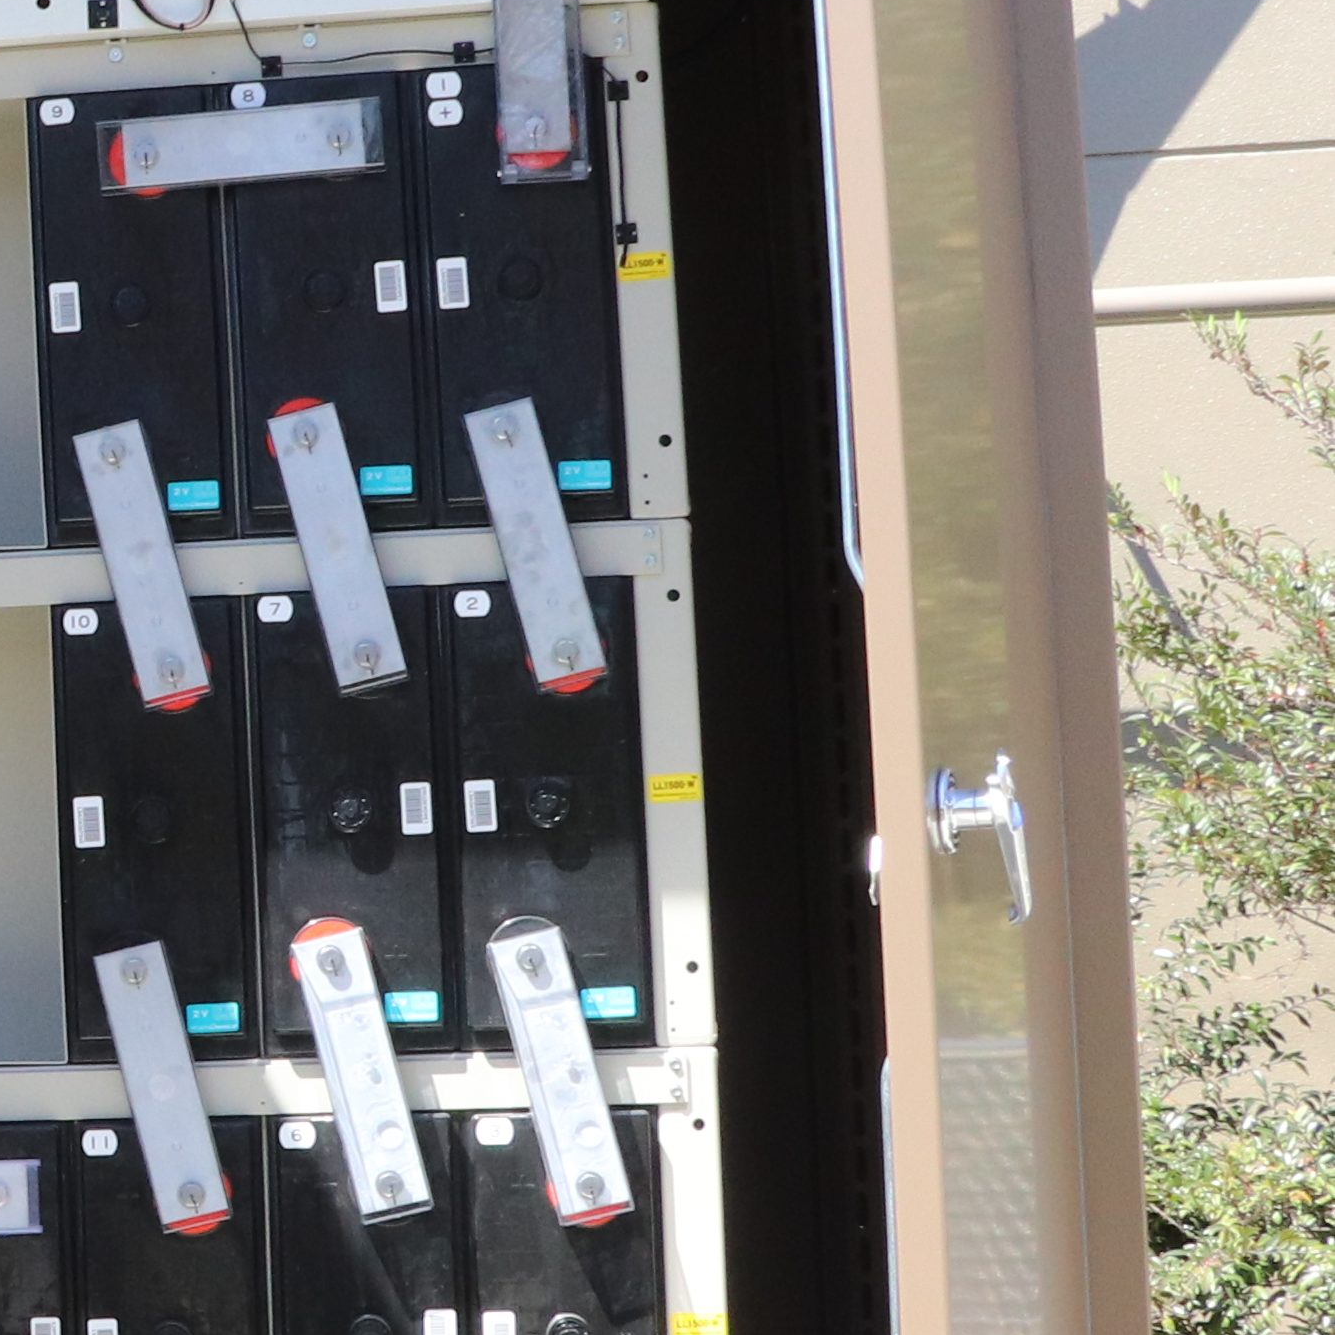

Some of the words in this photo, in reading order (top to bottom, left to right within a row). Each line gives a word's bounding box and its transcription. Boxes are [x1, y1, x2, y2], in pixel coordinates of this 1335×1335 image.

[242, 89, 255, 103] 8
[51, 105, 64, 119] 9
[269, 602, 281, 616] 7
[466, 596, 479, 611] 2
[71, 615, 91, 629] 10
[653, 780, 695, 791] LL1500-W
[91, 1136, 109, 1150] 11
[290, 1129, 301, 1143] 6
